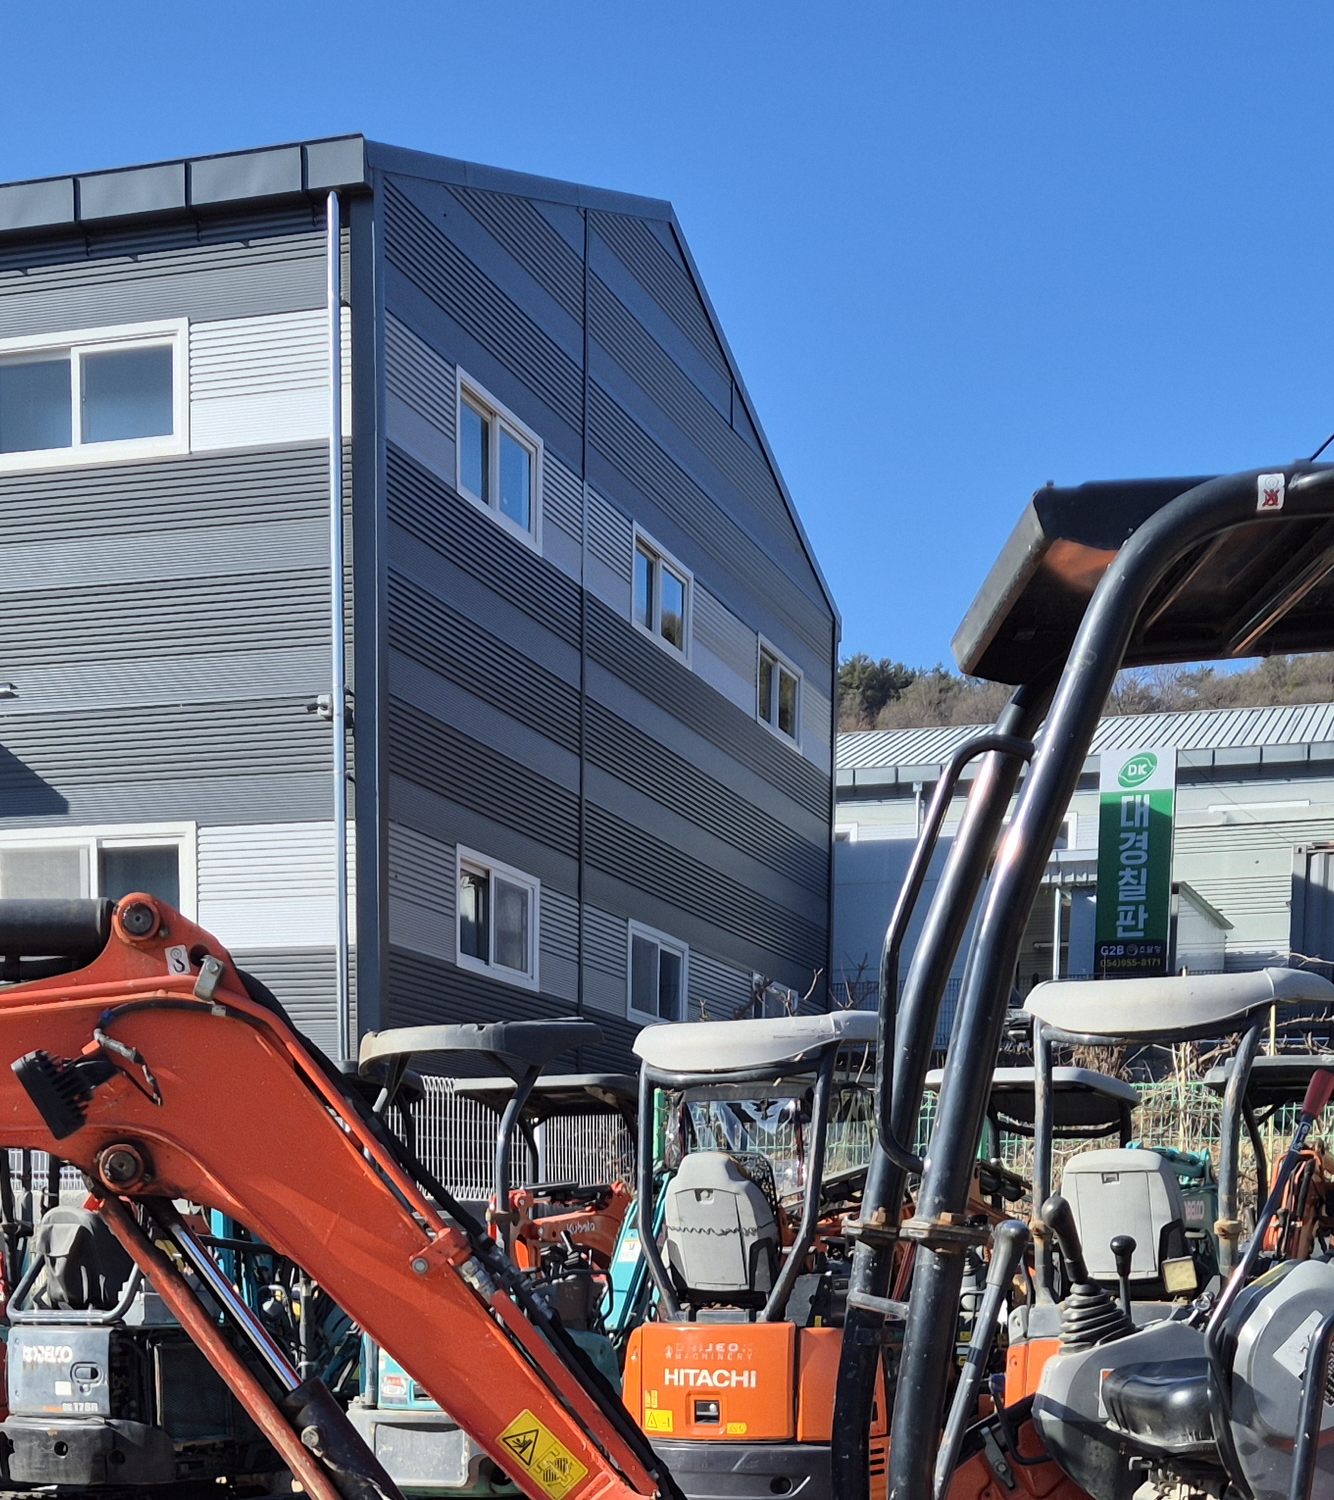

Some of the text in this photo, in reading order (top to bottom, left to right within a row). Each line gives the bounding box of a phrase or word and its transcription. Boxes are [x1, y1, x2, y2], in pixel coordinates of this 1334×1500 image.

[1116, 793, 1150, 938] 대경칠판
[1100, 945, 1124, 956] G2B
[567, 1220, 596, 1235] Kubota
[664, 1368, 757, 1388] HITACHI
